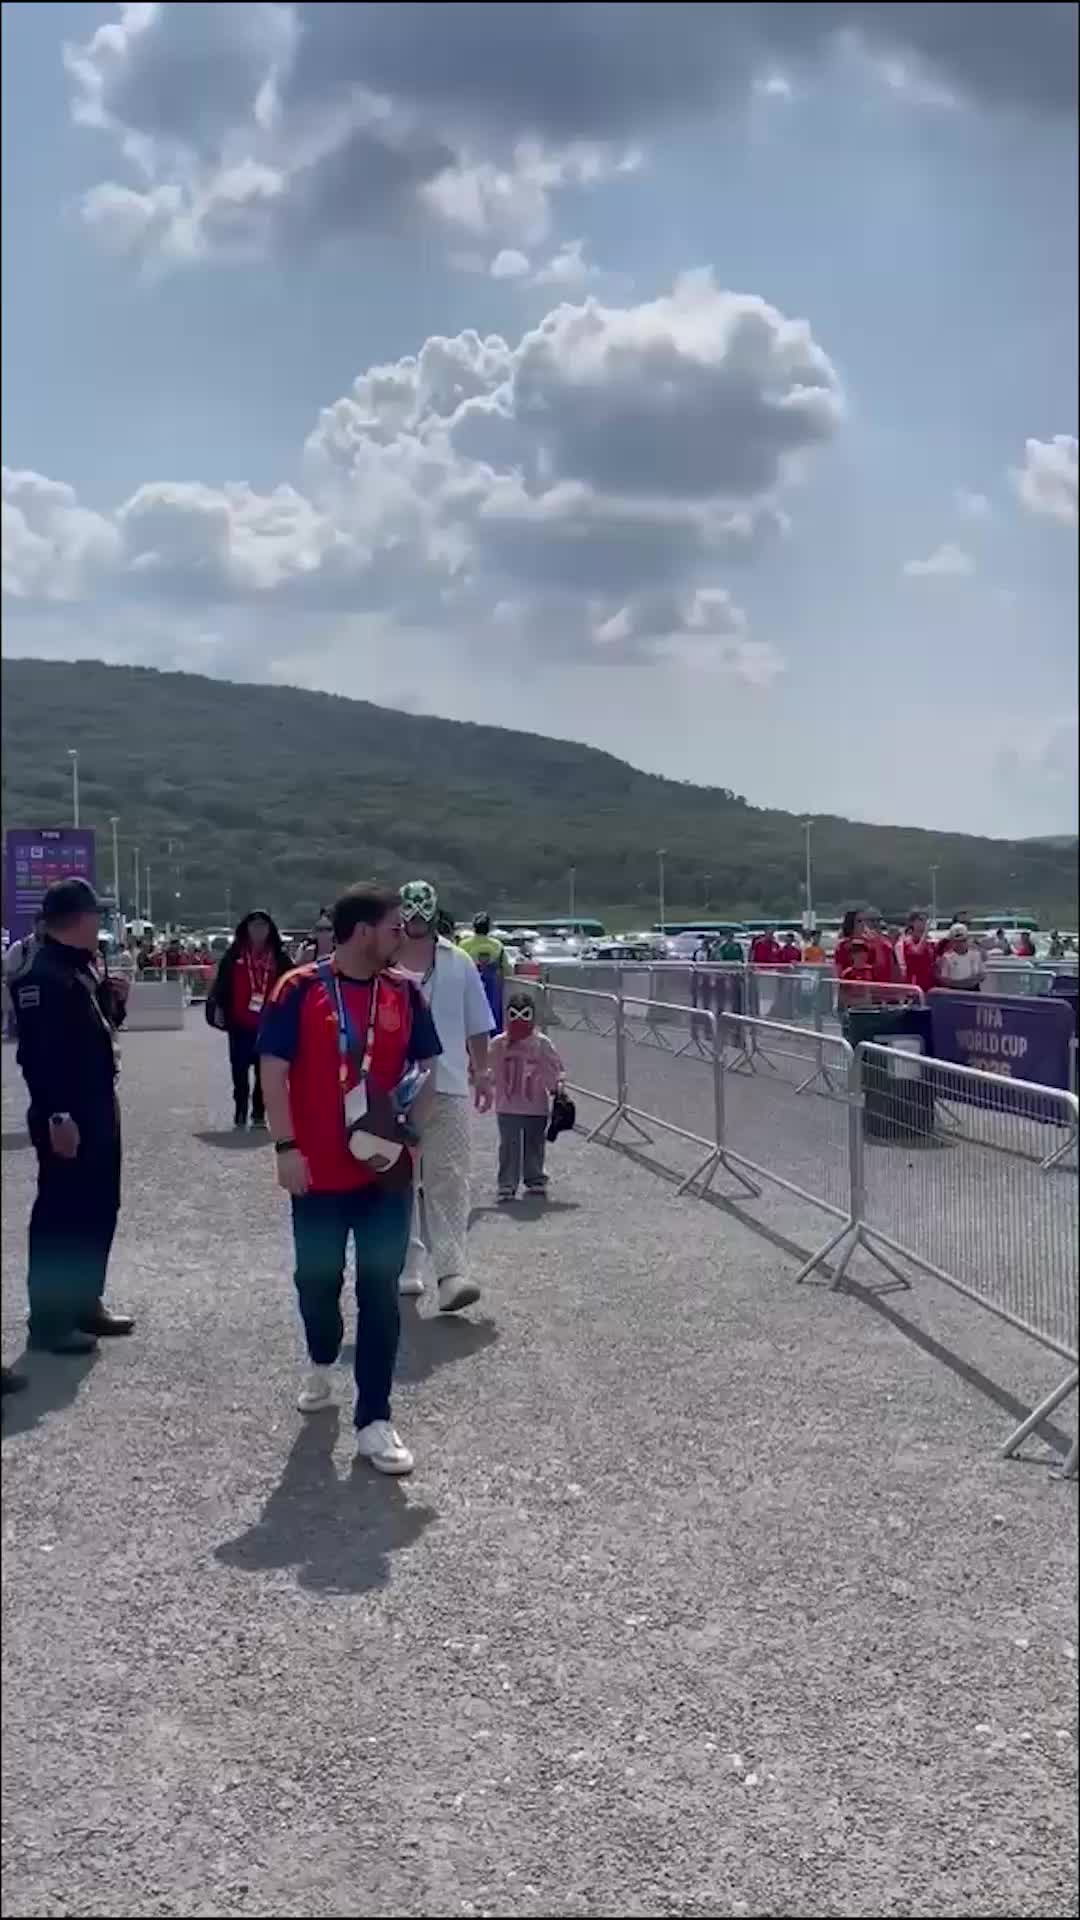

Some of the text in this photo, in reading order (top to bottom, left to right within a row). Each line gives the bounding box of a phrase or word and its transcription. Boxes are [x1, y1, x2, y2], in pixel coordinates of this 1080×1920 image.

[976, 1007, 1003, 1029] FIFA
[955, 1030, 1028, 1058] WORLD CUP
